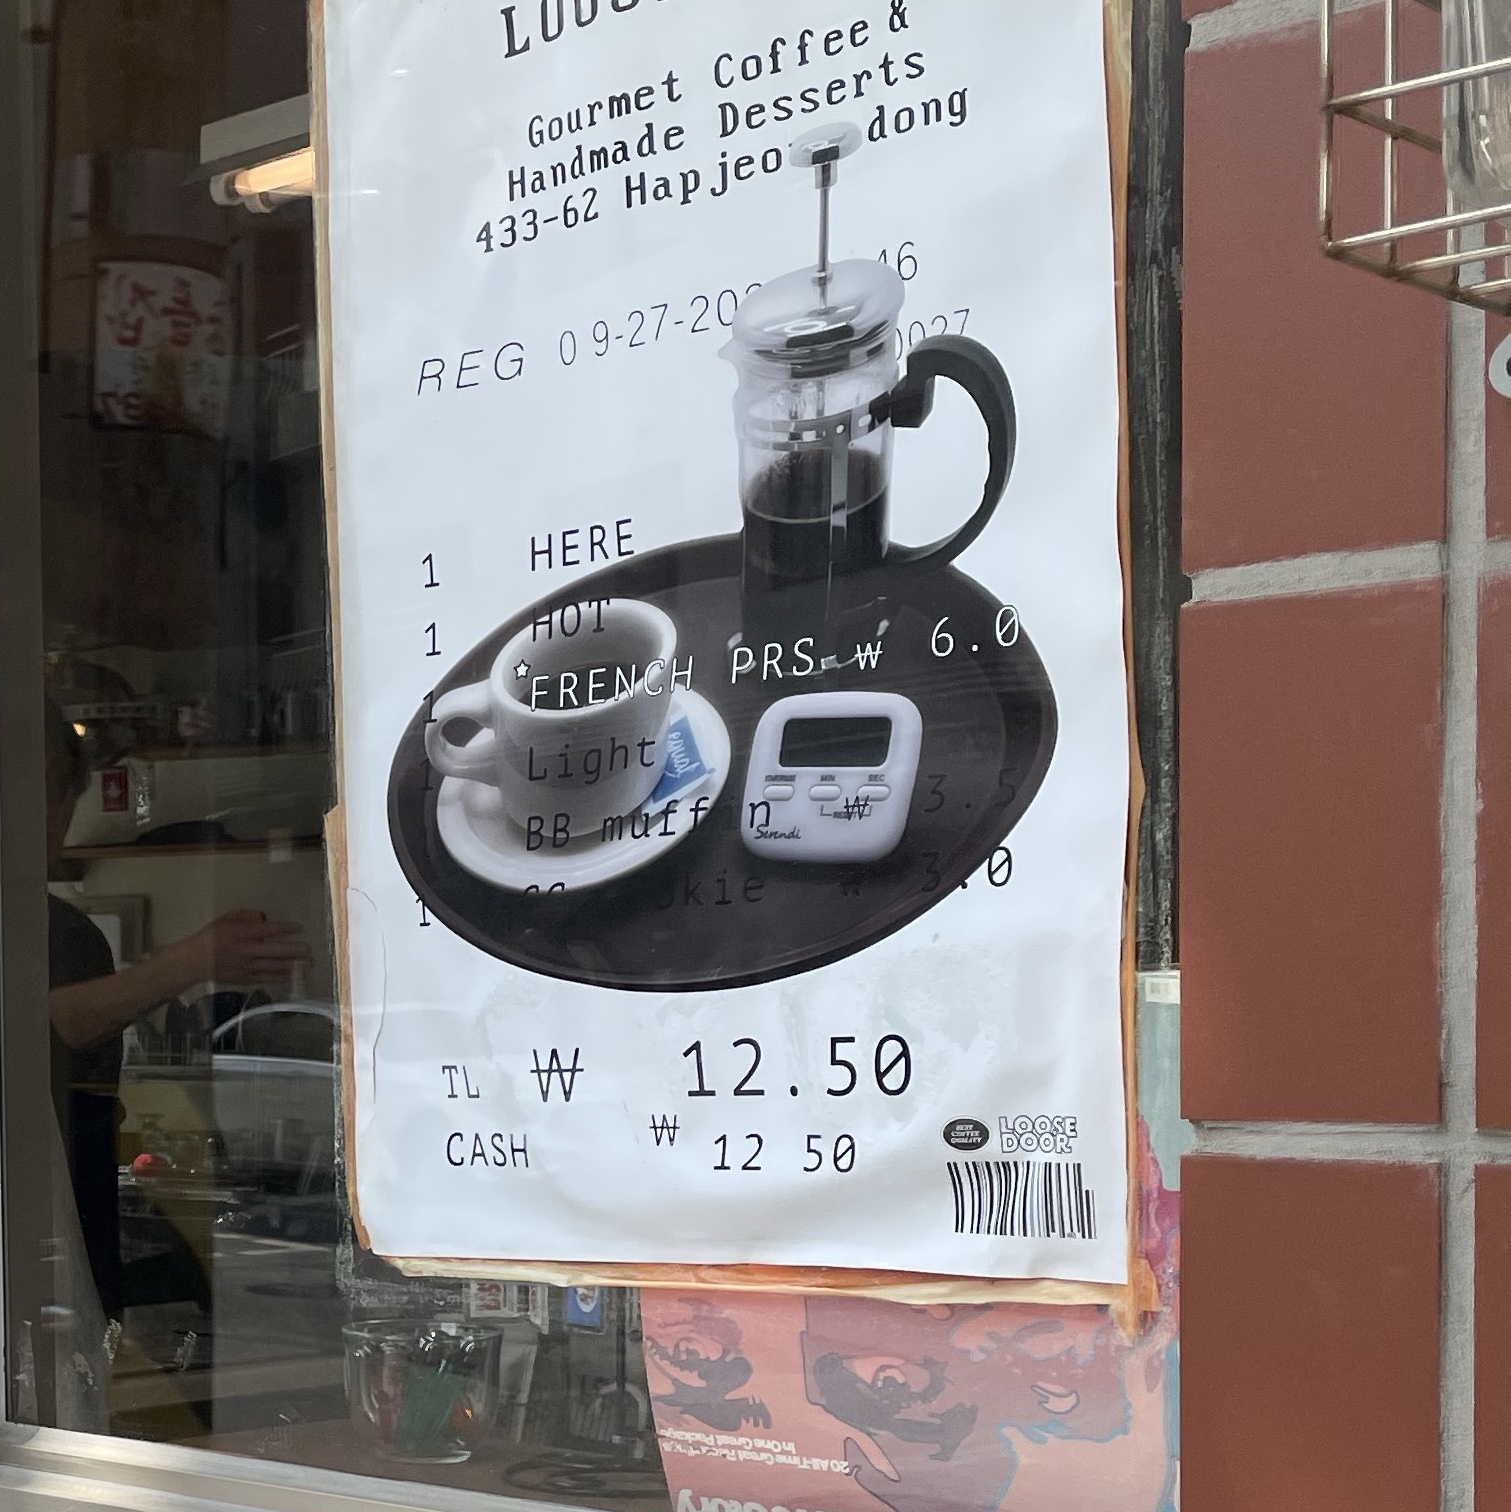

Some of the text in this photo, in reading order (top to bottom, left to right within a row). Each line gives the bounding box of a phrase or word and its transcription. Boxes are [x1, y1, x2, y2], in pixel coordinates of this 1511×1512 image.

[527, 0, 910, 149] Gourmet Coffee &
[507, 51, 926, 202] Handmade Desserts
[475, 187, 600, 254] 433-62
[417, 341, 526, 396] REG
[421, 518, 635, 588] 1 HERE
[424, 598, 611, 656] 1 HOT
[422, 690, 438, 724] 1
[530, 654, 695, 712] FRENCH
[731, 637, 815, 685] PRS
[527, 736, 656, 785] Light
[867, 773, 886, 783] SEC
[525, 812, 571, 852] BB
[600, 796, 771, 843] muffn
[415, 893, 431, 928] 1
[441, 1033, 913, 1103] TL ₩ 12.50
[446, 1132, 530, 1168] CASH
[648, 1113, 681, 1147] ₩
[998, 1114, 1078, 1138] LOOSE
[1000, 1131, 1073, 1154] DOOR
[715, 1434, 753, 1450] Great
[739, 1449, 775, 1466] Great
[753, 1438, 781, 1453] One
[775, 1454, 830, 1471] All-Time
[781, 1440, 796, 1454] In
[830, 1459, 850, 1474] 20
